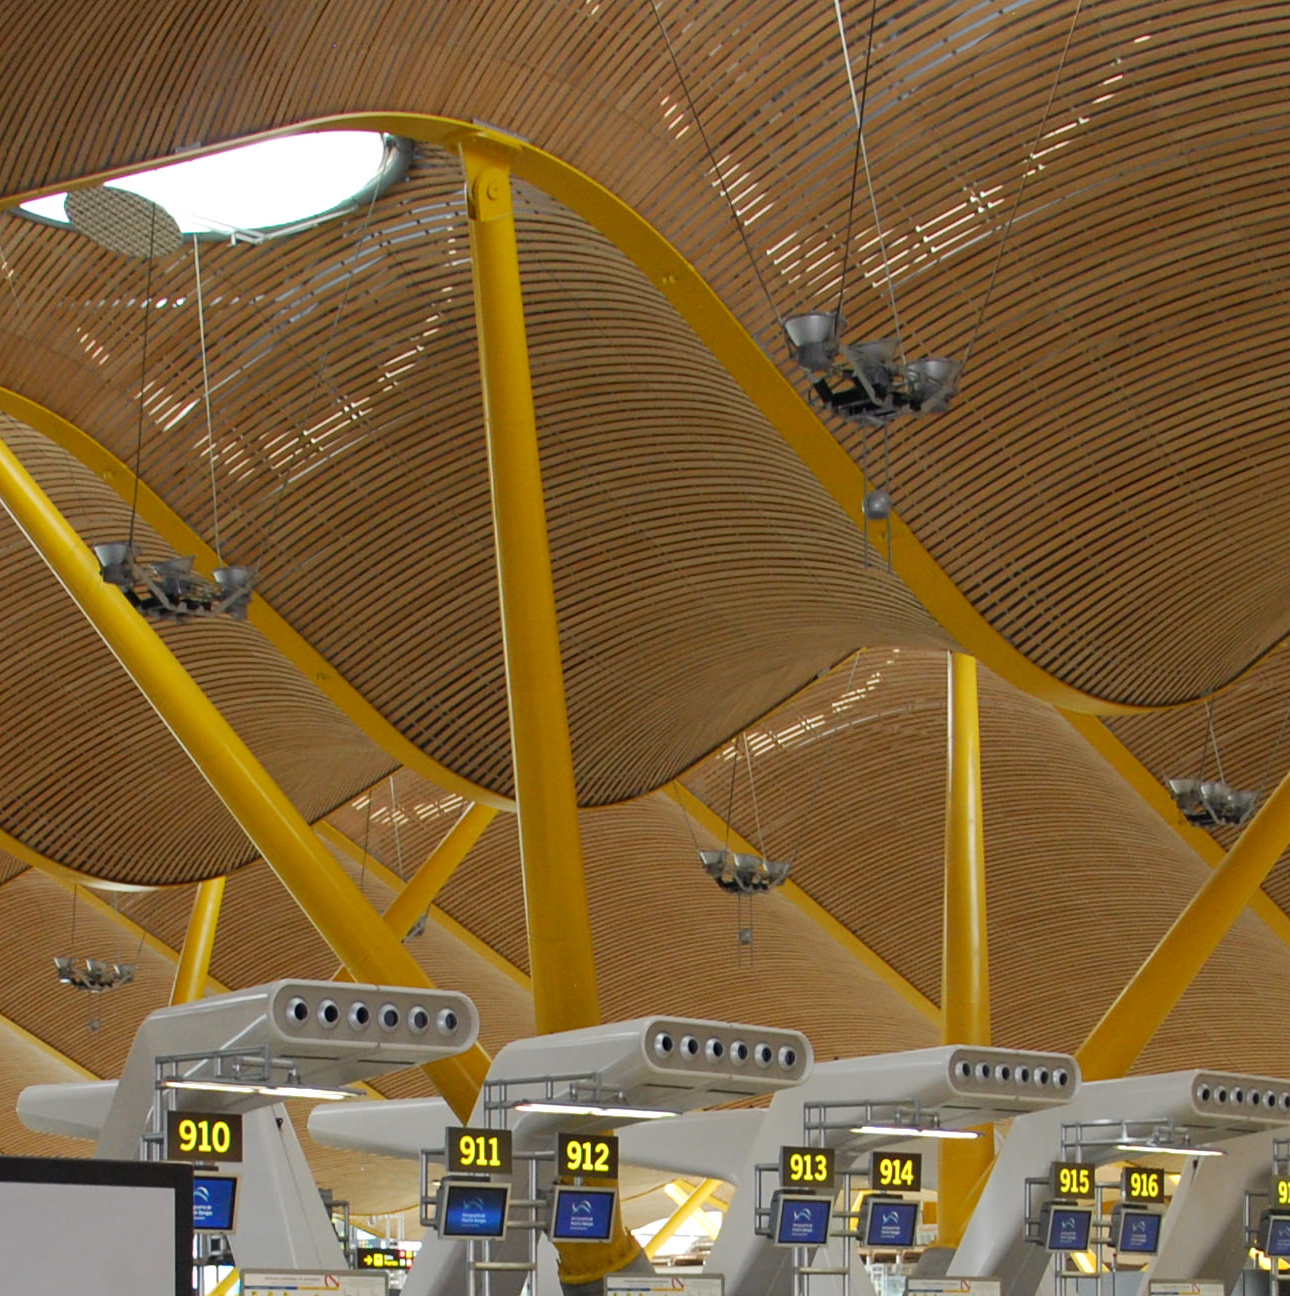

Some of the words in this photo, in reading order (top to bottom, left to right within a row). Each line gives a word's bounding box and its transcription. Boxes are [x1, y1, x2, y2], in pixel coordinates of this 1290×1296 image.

[178, 1119, 231, 1153] 910
[459, 1135, 502, 1167] 911
[566, 1140, 610, 1172] 912
[790, 1153, 828, 1181] 913
[879, 1158, 914, 1186] 914
[1059, 1168, 1090, 1194] 915
[1130, 1172, 1159, 1198] 916
